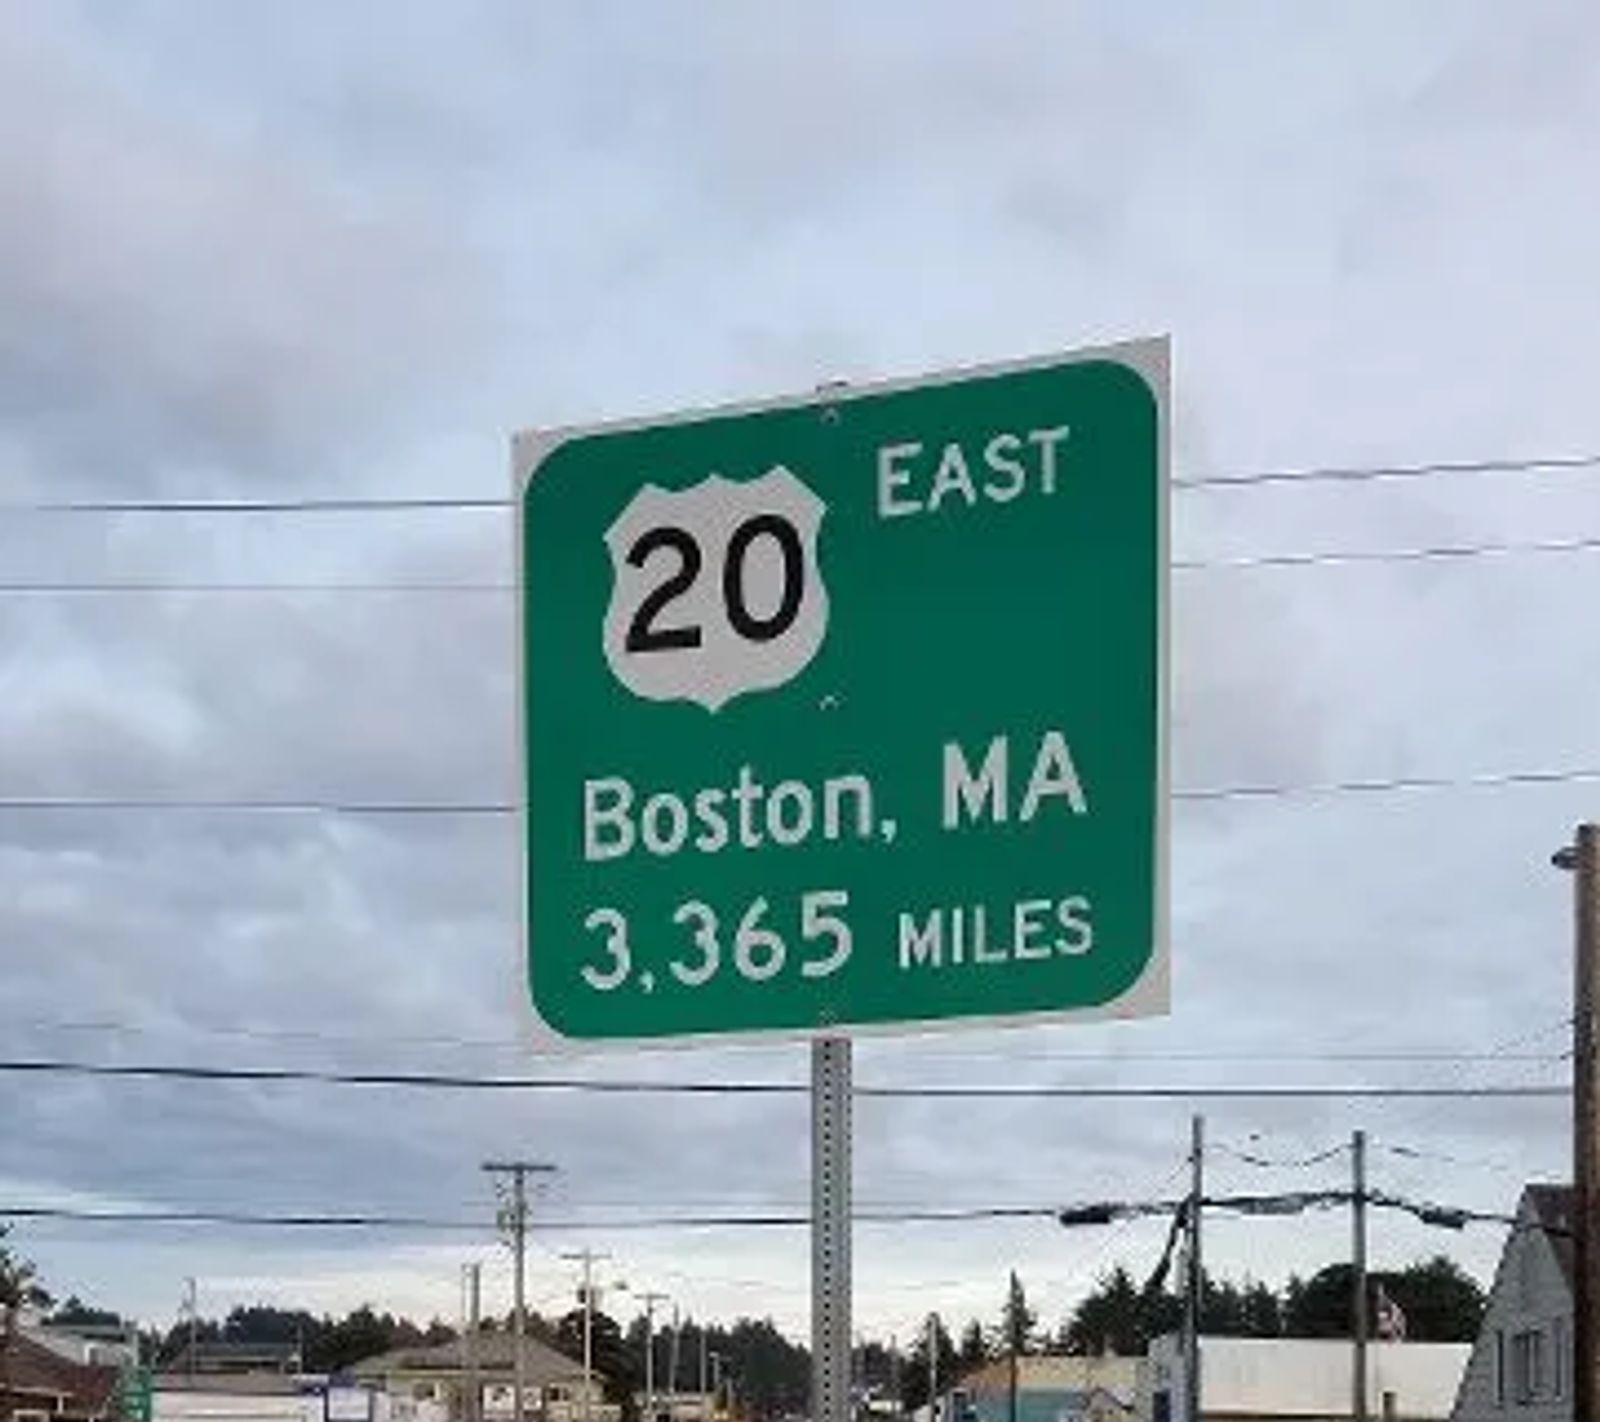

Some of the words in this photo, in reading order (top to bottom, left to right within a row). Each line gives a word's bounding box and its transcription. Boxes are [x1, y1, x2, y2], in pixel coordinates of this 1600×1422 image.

[876, 425, 1070, 518] EAST
[625, 514, 804, 653] 20
[583, 765, 896, 861] Boston,
[942, 730, 1088, 829] MA
[580, 890, 853, 992] 3,365
[898, 896, 1093, 969] MILES
